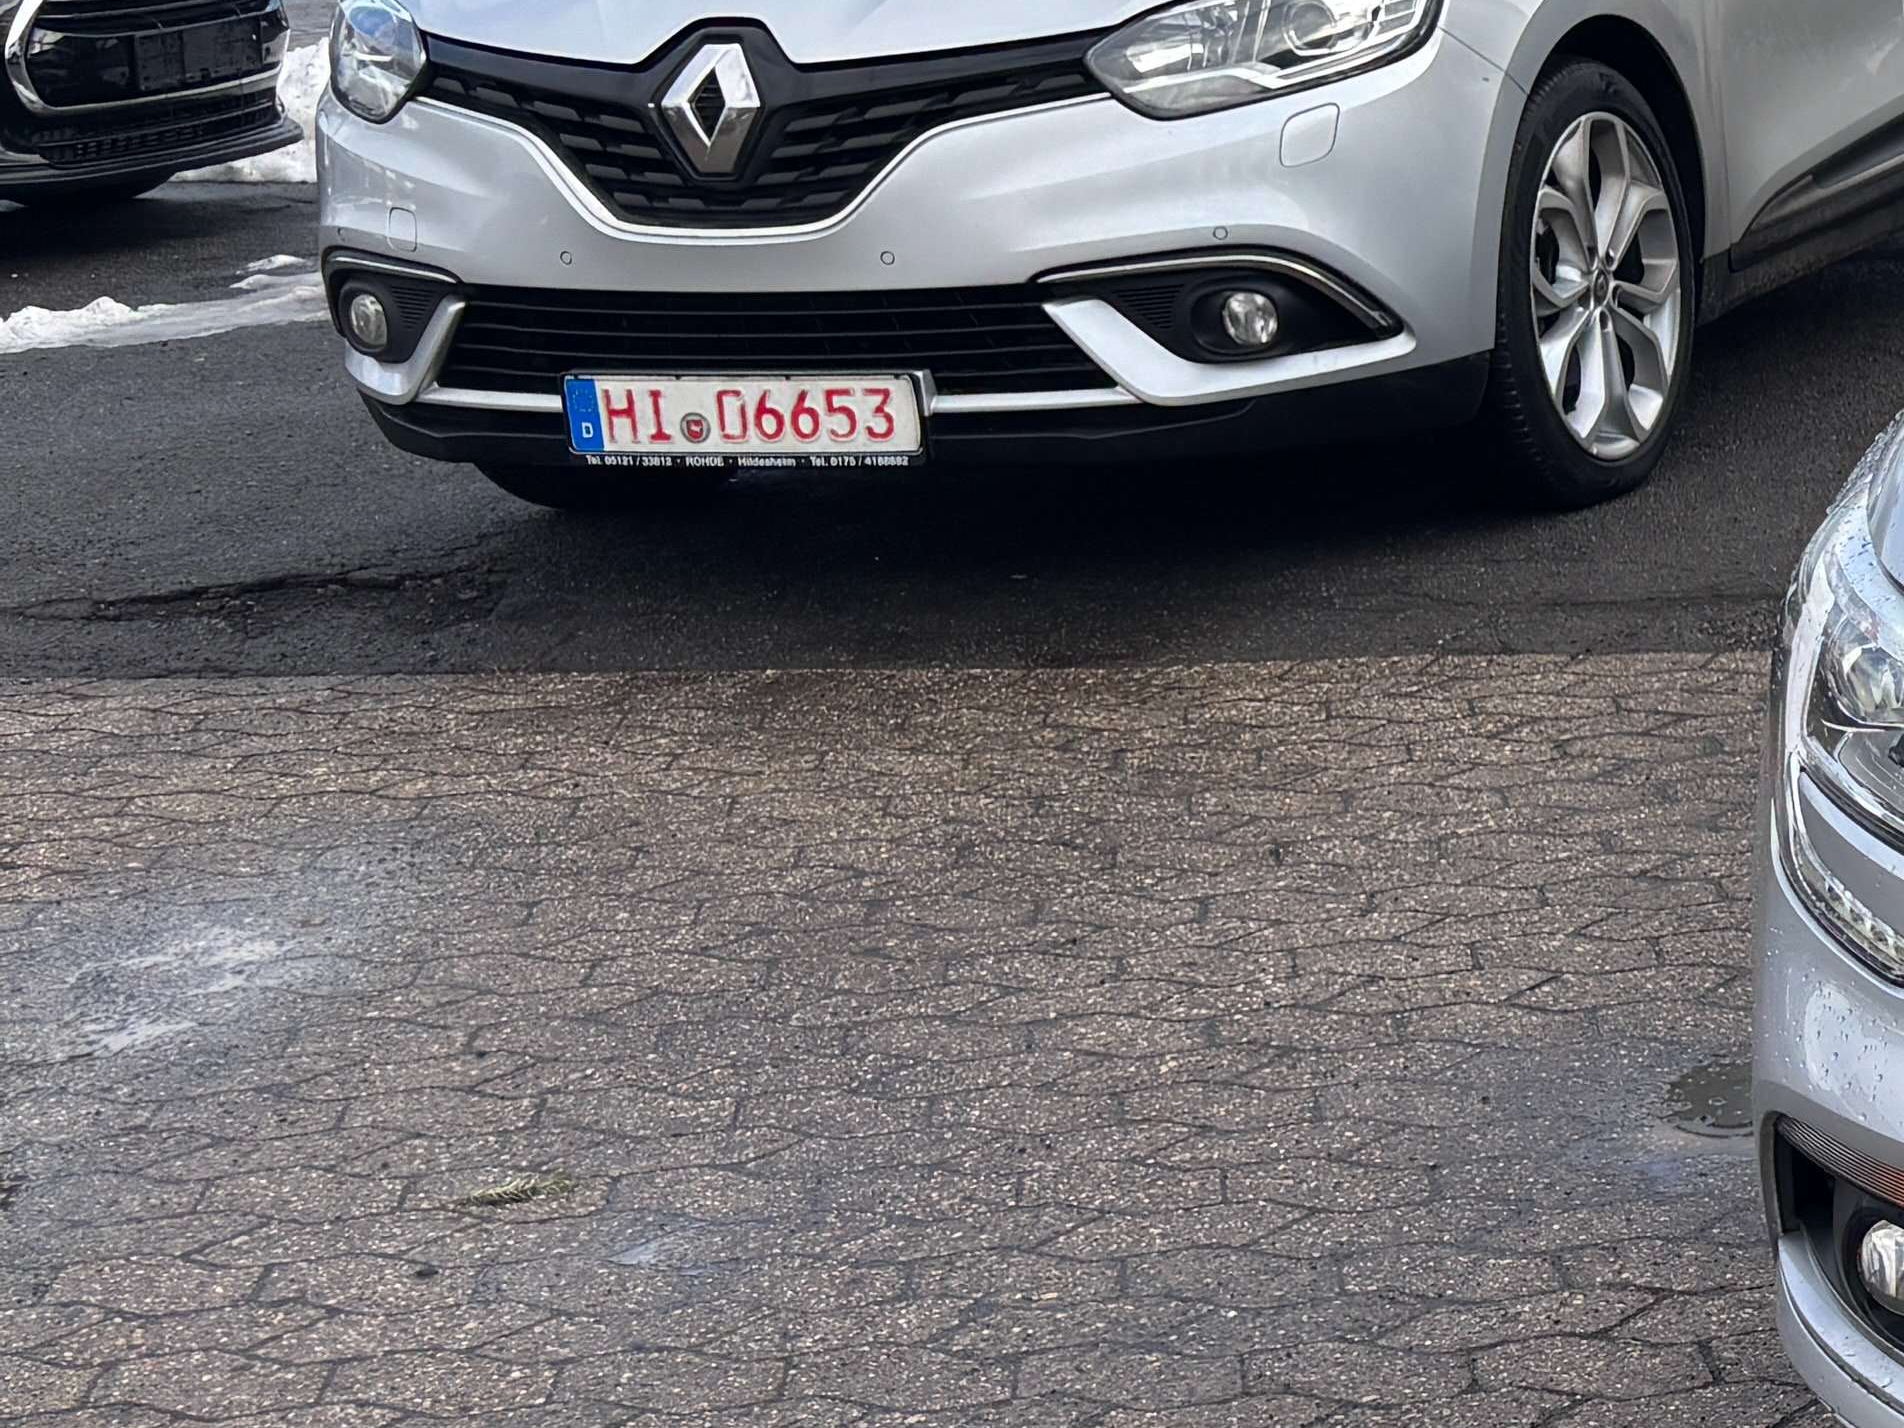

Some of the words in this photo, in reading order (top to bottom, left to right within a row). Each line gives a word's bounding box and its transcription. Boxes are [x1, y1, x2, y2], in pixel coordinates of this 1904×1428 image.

[602, 388, 672, 443] HI
[716, 387, 895, 443] 06653
[581, 422, 594, 438] D
[685, 456, 725, 467] ROHDE
[809, 456, 826, 467] Tel.
